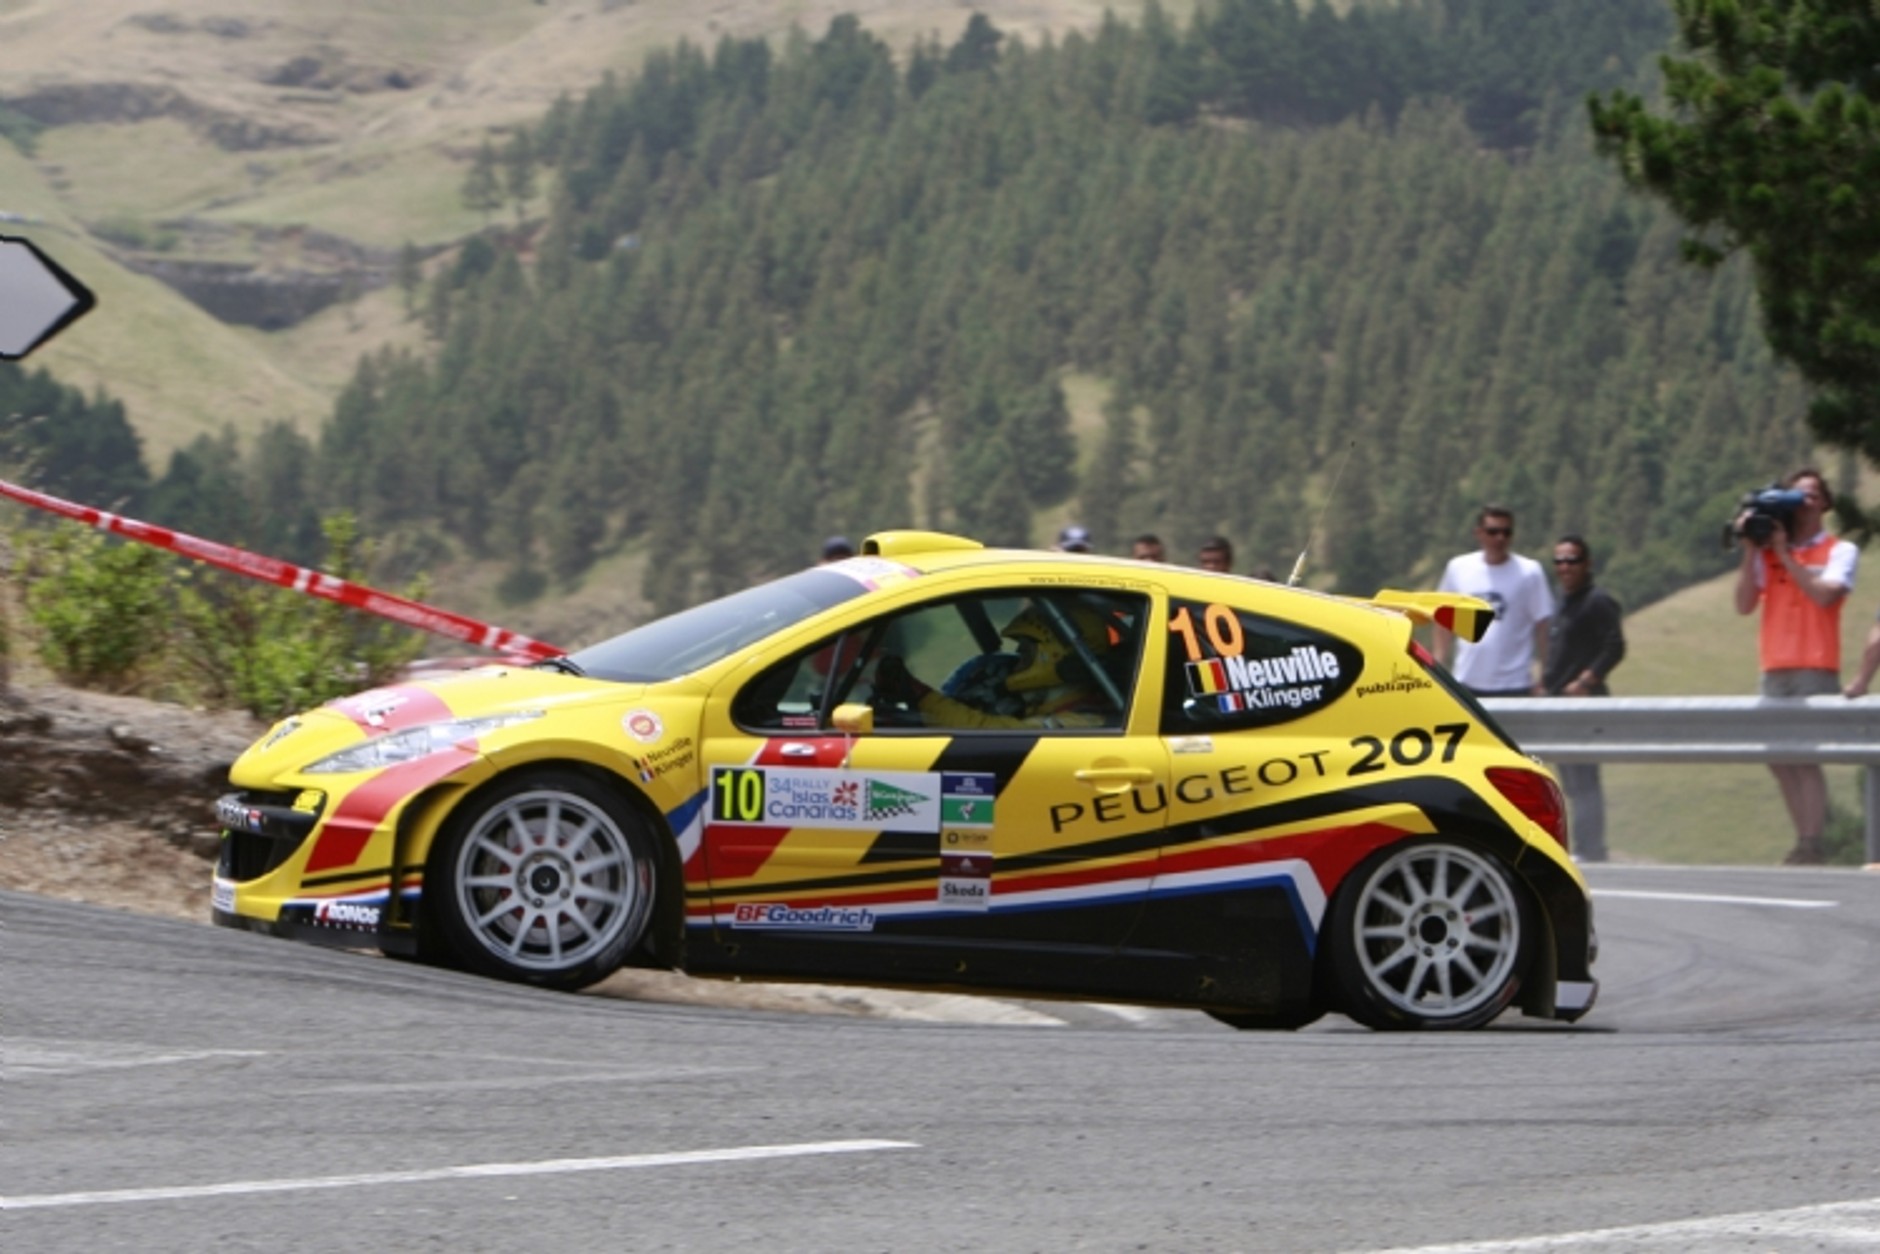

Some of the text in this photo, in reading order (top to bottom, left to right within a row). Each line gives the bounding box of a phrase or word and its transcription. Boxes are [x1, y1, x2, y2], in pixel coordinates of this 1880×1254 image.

[1168, 602, 1246, 661] 10
[1226, 645, 1340, 691] Neuville
[1244, 684, 1323, 709] Klinger
[645, 737, 692, 763] Neuville
[769, 777, 830, 794] 34 RALLY
[1050, 722, 1470, 833] PEUGEOT 207
[716, 770, 761, 822] 10
[792, 790, 829, 804] Islas
[768, 800, 857, 821] Canarias
[943, 881, 985, 897] Škoda
[736, 904, 875, 924] BFGoodrich
